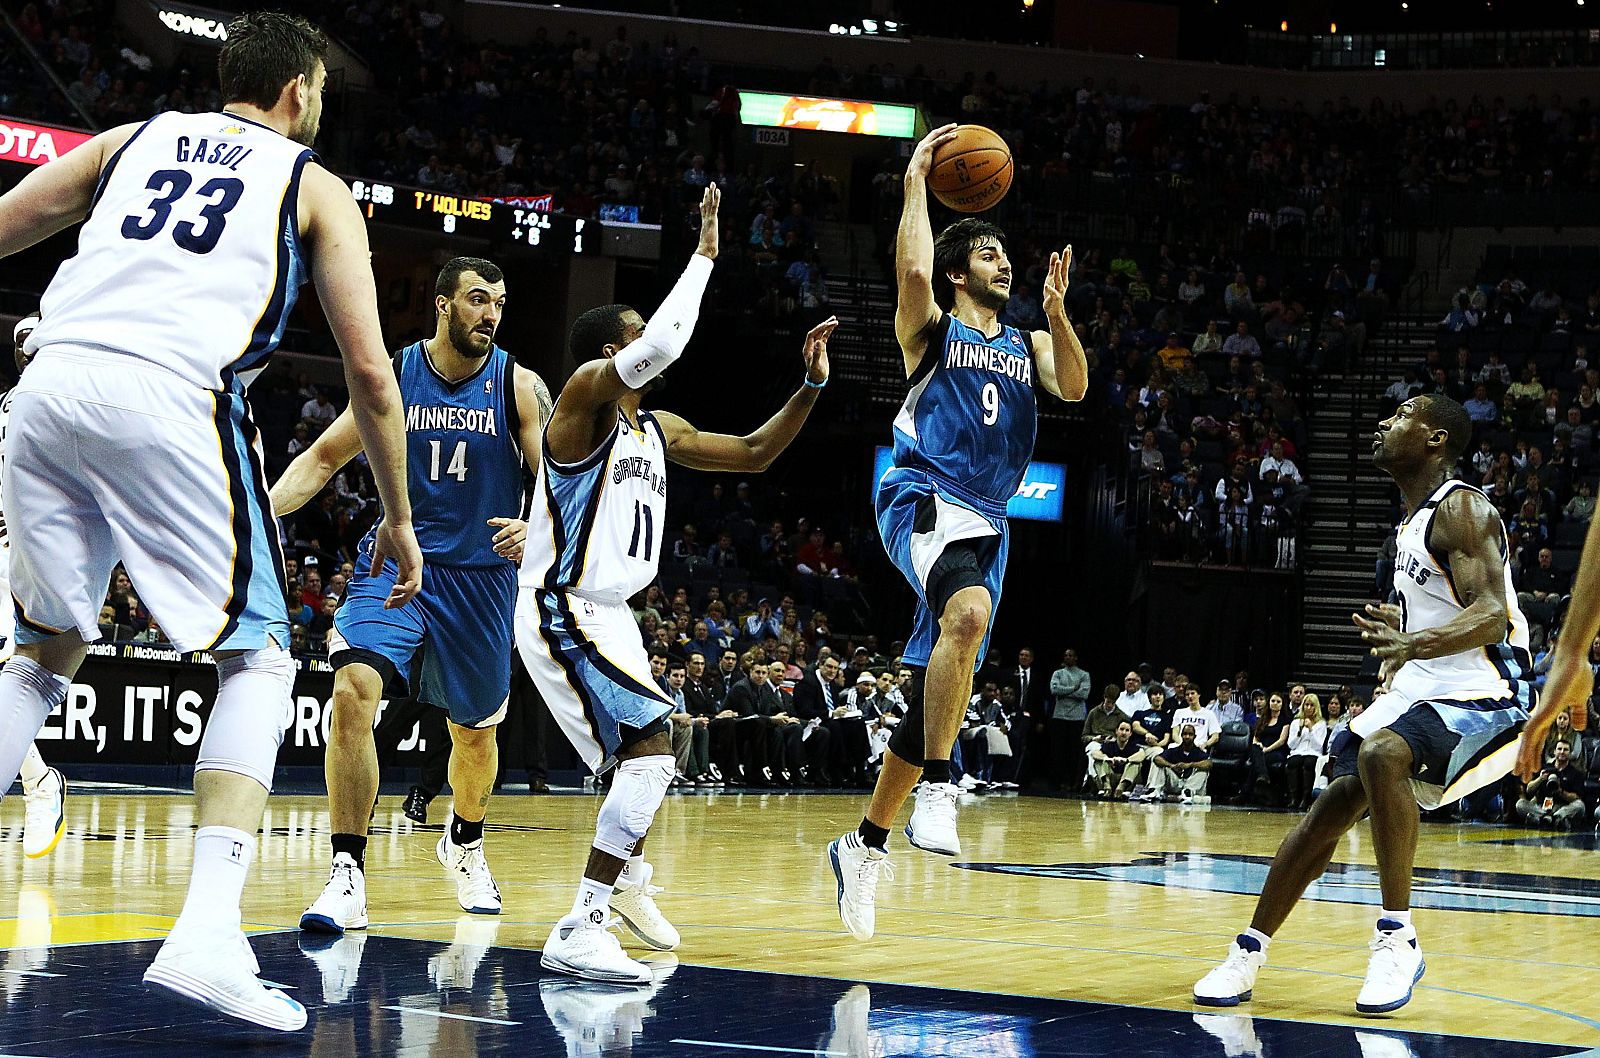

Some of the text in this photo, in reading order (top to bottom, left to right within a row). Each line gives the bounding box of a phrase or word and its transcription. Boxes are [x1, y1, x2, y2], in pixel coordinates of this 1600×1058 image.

[176, 135, 252, 171] GASOL
[758, 128, 786, 144] 103A
[121, 169, 244, 254] 33
[415, 191, 492, 221] T'WOLVES
[574, 234, 582, 252] 1
[945, 341, 1033, 388] MINNESOTA
[405, 404, 498, 437] MINNESOTA
[981, 382, 999, 426] 9
[429, 440, 469, 482] 14
[627, 499, 653, 562] 11
[123, 685, 203, 746] IT'S
